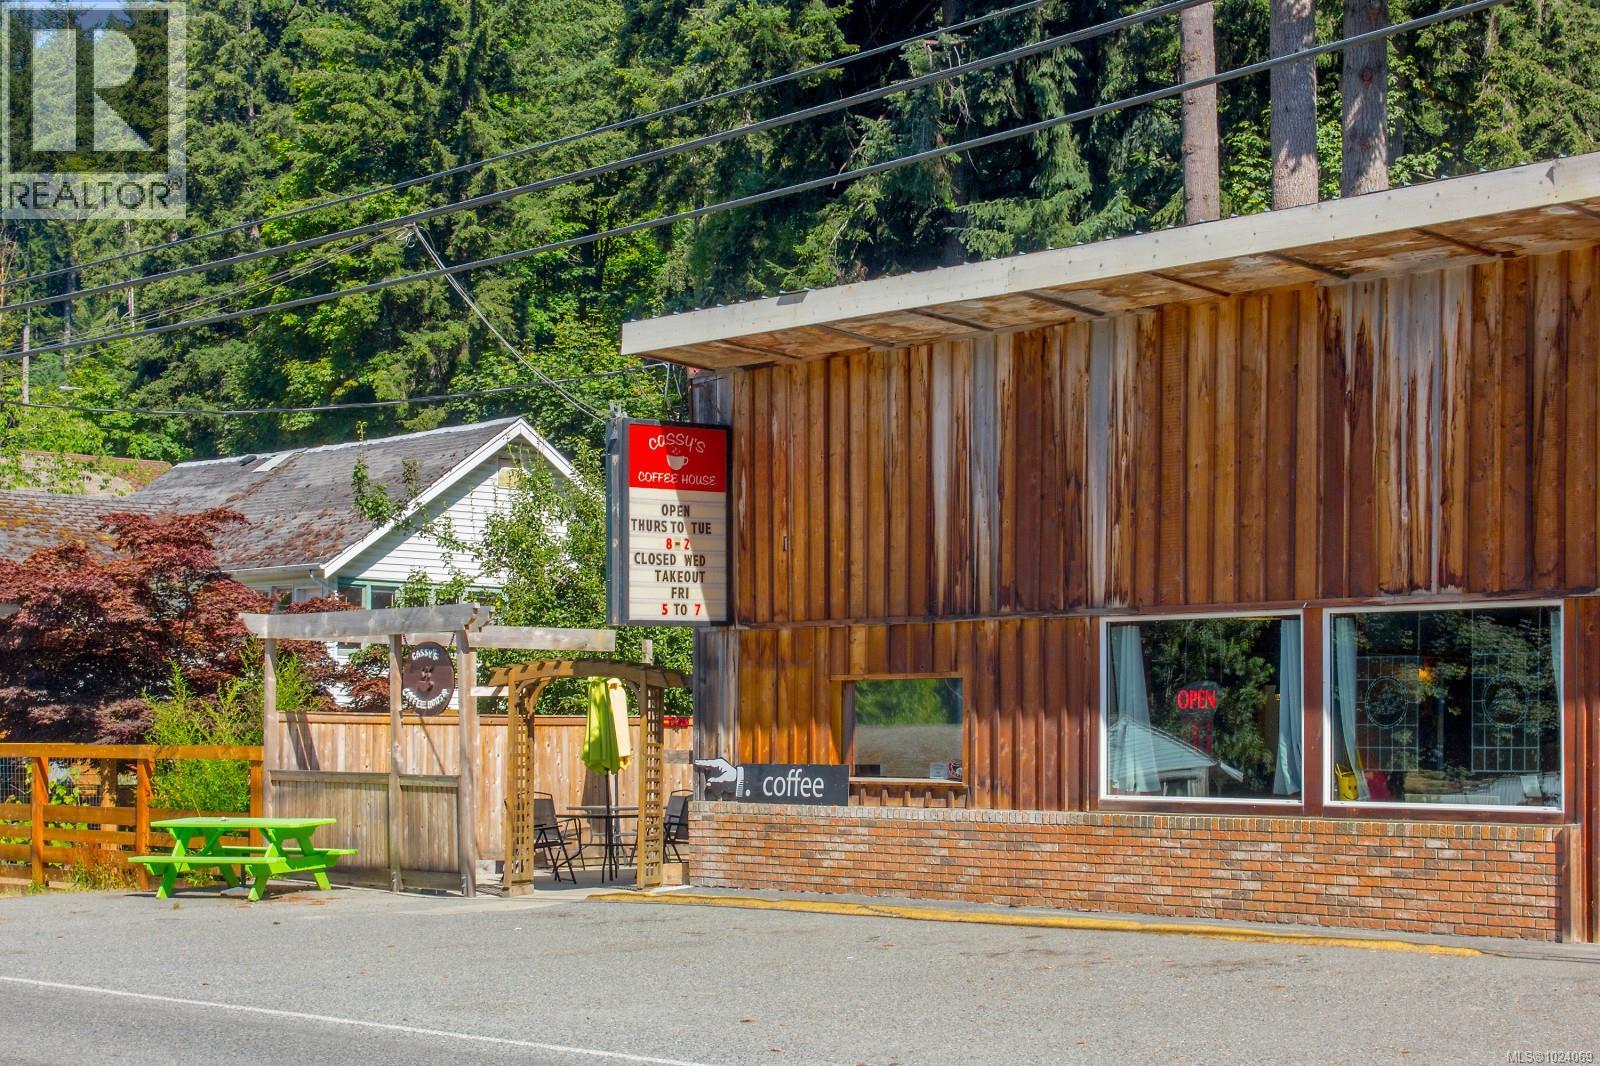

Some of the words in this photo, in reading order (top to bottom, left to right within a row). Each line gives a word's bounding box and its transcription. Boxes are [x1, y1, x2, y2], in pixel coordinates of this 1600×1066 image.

[638, 471, 678, 483] COFFEE
[681, 474, 717, 486] HOUSE
[661, 504, 690, 517] OPEN
[631, 518, 667, 533] THURS
[671, 520, 684, 533] TO
[691, 521, 712, 535] TUE
[634, 552, 676, 566] CLOSED
[684, 554, 706, 567] WED
[654, 569, 706, 583] TAKEOUT
[671, 587, 689, 600] FRI
[661, 603, 668, 616] 5
[673, 603, 688, 616] TO
[694, 604, 701, 616] 7
[402, 687, 427, 709] COFFEE
[427, 688, 449, 709] HOUSE
[1177, 689, 1217, 710] OPEN
[762, 768, 825, 797] coffee
